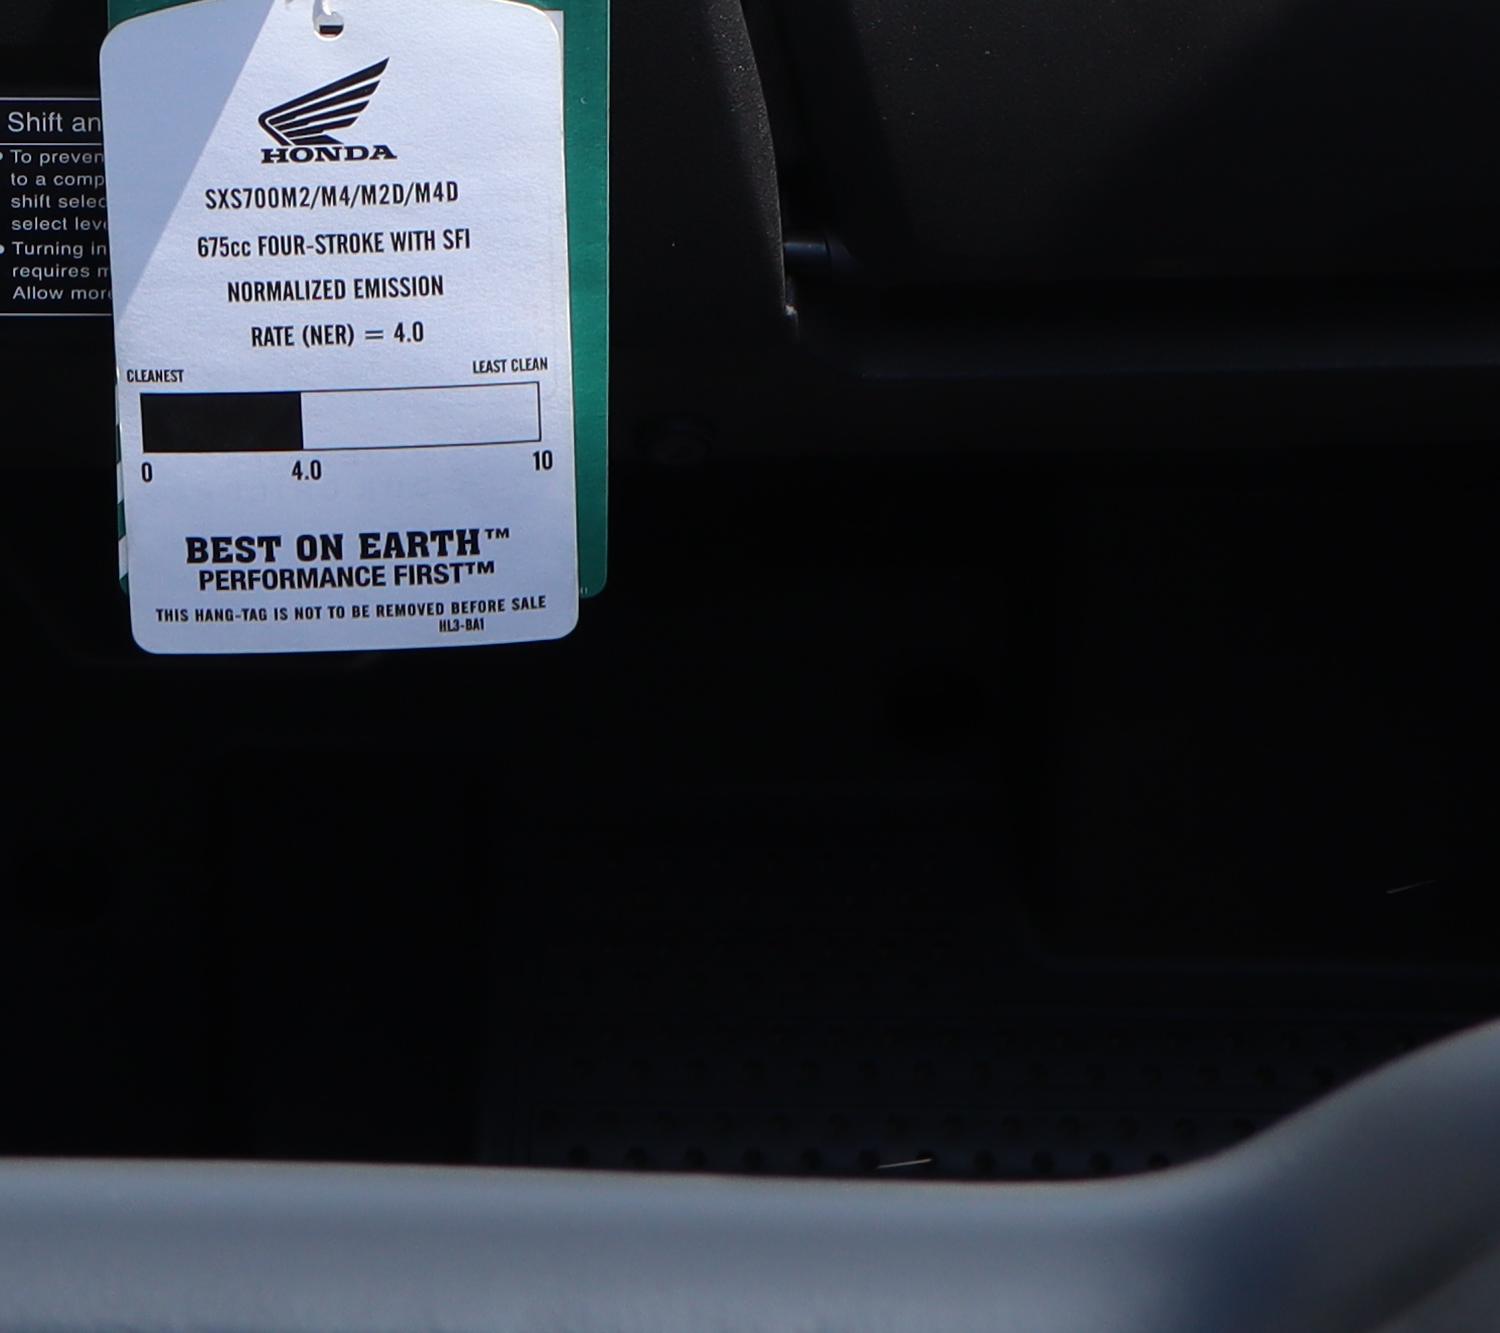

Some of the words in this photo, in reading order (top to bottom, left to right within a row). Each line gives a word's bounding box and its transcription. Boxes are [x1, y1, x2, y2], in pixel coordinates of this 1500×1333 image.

[7, 111, 64, 133] Shift
[9, 149, 33, 165] To
[260, 144, 398, 165] HONDA
[10, 172, 28, 187] to
[35, 175, 47, 187] a
[10, 193, 52, 209] shift
[204, 180, 459, 211] SXS700M2/M4/M2D/M4D
[10, 216, 68, 231] select
[11, 240, 84, 259] Turning
[197, 235, 252, 258] 675cc
[258, 231, 385, 257] FOUR-STROKE
[389, 229, 436, 252] WITH
[442, 227, 471, 250] SFI
[12, 265, 91, 282] requires
[12, 285, 64, 301] Allow
[227, 278, 346, 303] NORMALIZED
[353, 274, 444, 300] EMISSION
[251, 325, 296, 348] RATE
[302, 323, 356, 349] (NER)
[393, 320, 424, 343] 4.0
[126, 368, 184, 384] CLEANEST
[472, 359, 507, 375] LEAST
[510, 357, 549, 373] CLEAN
[140, 461, 154, 483] 0
[291, 459, 322, 482] 4.0
[532, 449, 554, 472] 10
[185, 535, 282, 565] BEST
[296, 533, 344, 562] ON
[199, 564, 387, 592] PERFORMANCE
[155, 607, 190, 623] THIS
[194, 606, 268, 623] HANG-TAG
[273, 607, 289, 621] IS
[294, 605, 322, 621] NOT
[326, 605, 346, 620] TO
[351, 604, 370, 619] BE
[376, 601, 445, 618] REMOVED
[450, 598, 506, 615] BEFORE
[510, 594, 547, 611] SALE
[438, 617, 485, 633] HL3-BA1
